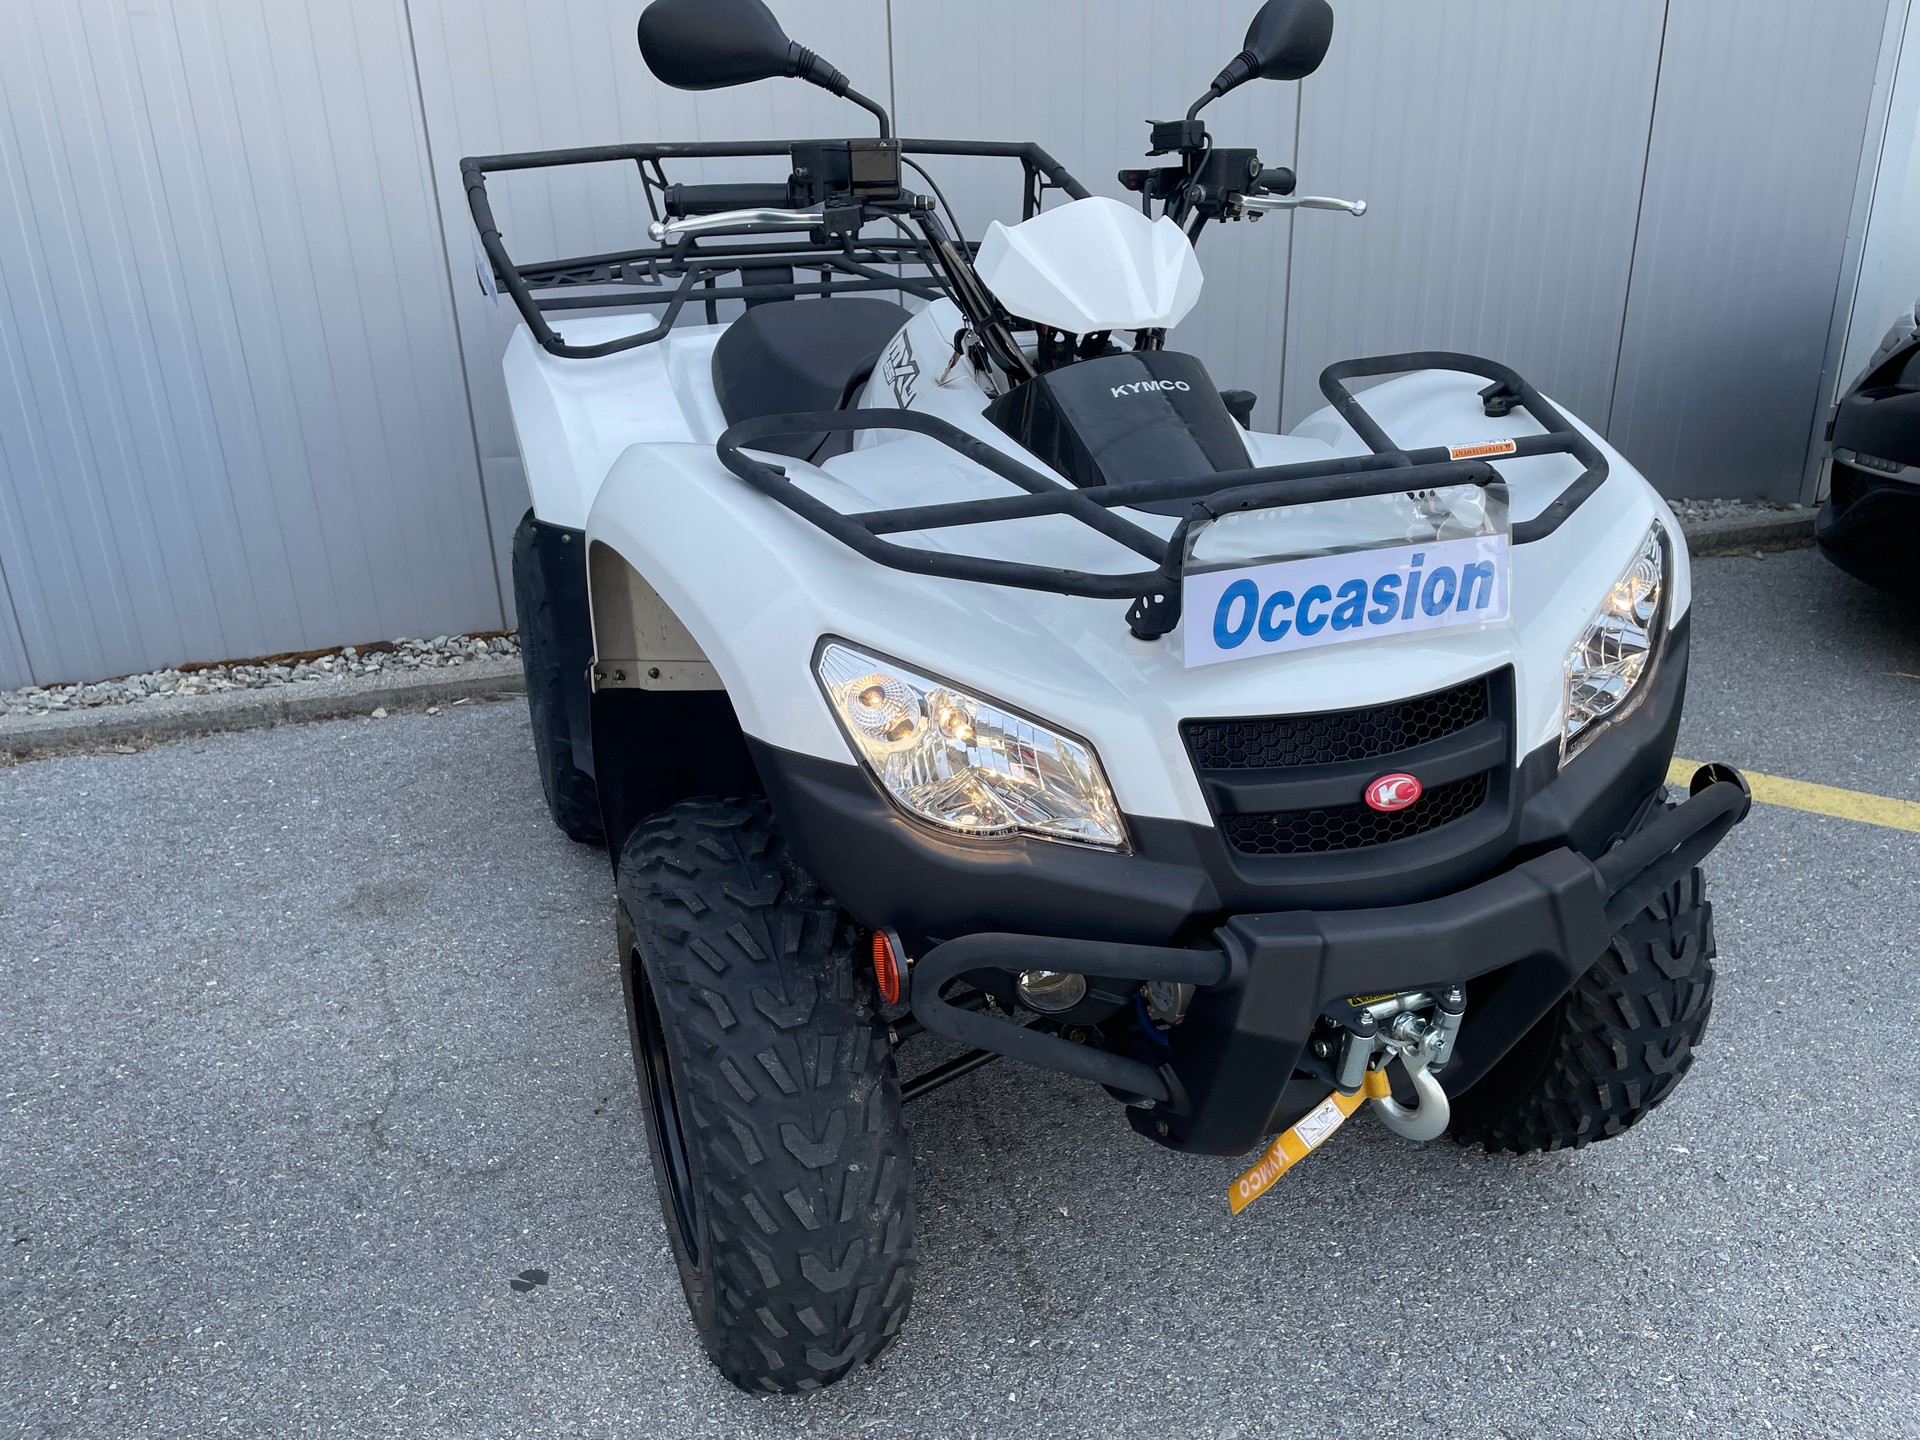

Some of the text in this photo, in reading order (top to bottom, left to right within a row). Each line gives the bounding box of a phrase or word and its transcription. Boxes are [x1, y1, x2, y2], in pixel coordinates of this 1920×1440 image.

[1110, 380, 1191, 398] KYMCO
[1213, 553, 1495, 650] Occasion
[1239, 1143, 1290, 1198] KYMCO
